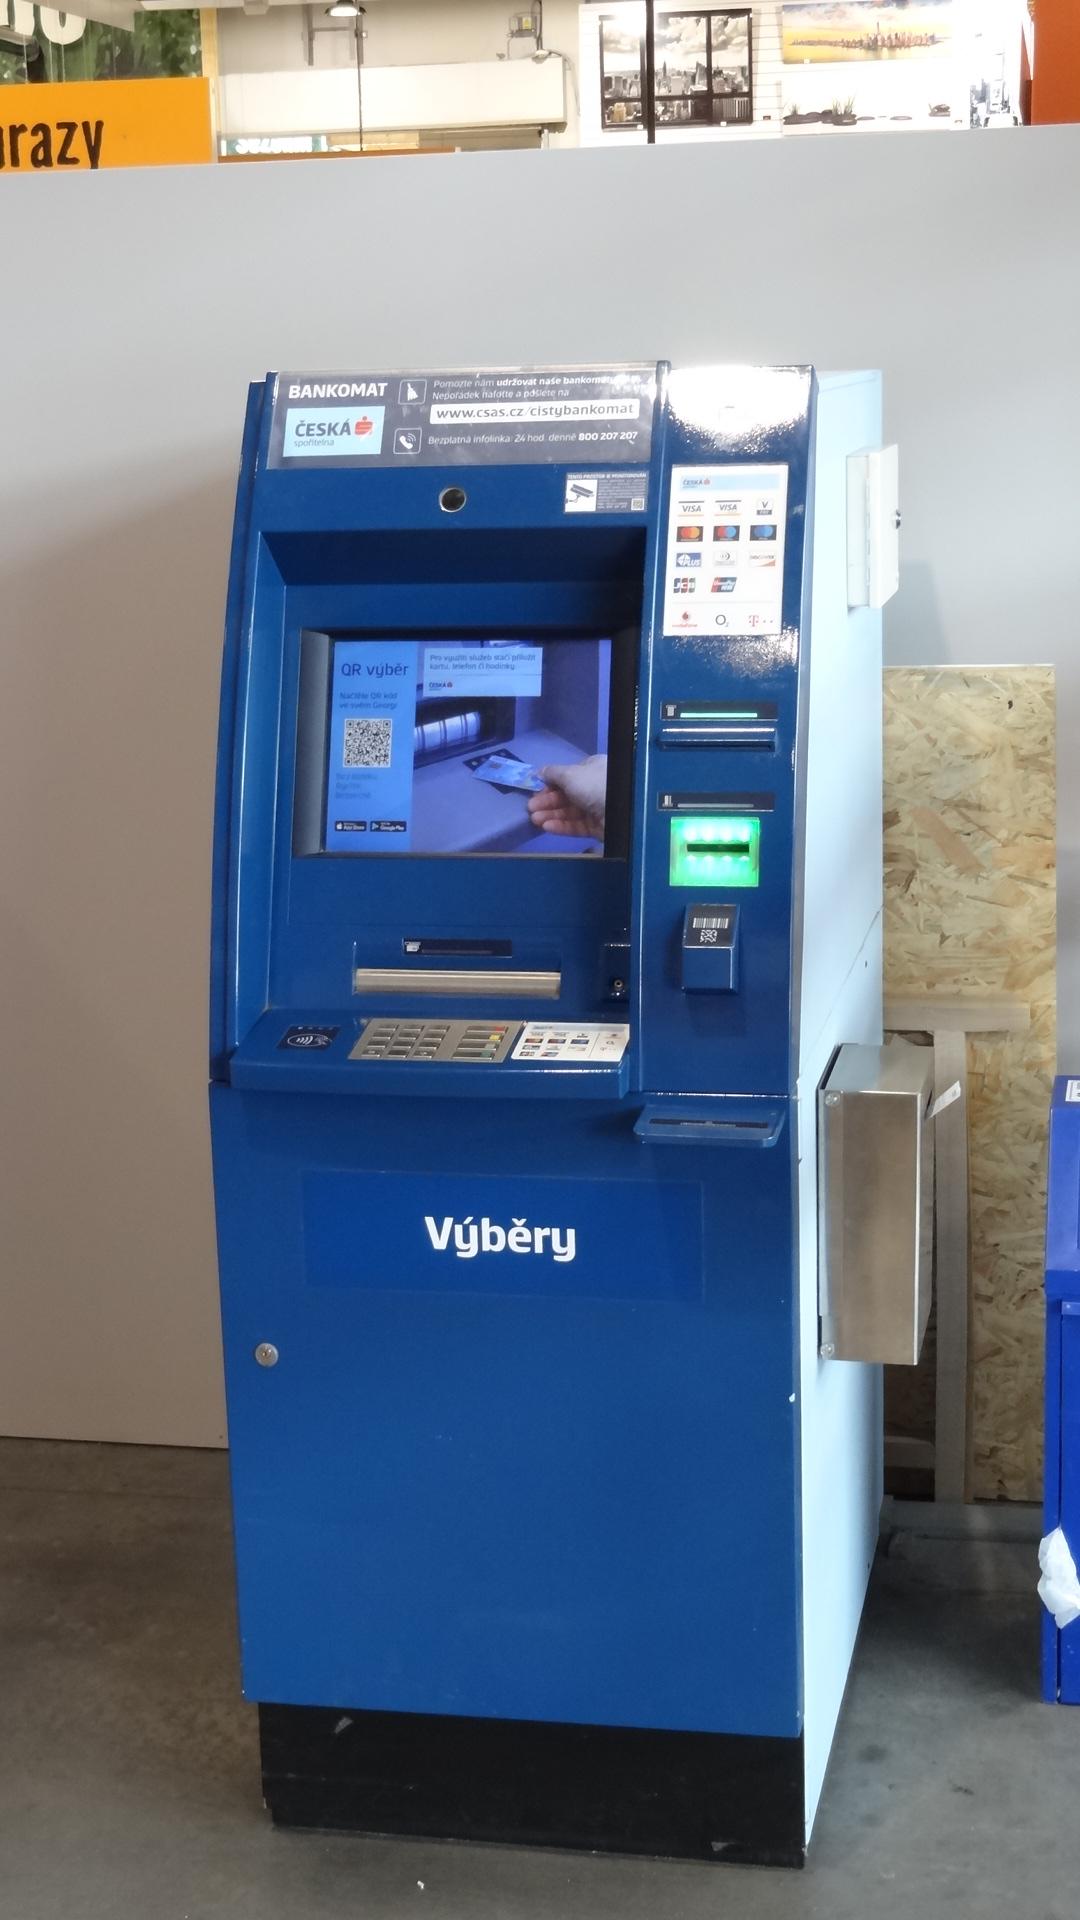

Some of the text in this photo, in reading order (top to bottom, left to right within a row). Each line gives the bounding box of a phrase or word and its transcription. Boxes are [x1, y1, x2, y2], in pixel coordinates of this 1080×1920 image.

[0, 120, 104, 169] razy
[433, 379, 472, 388] Pomozte
[474, 378, 494, 387] nám
[496, 377, 537, 386] udržovat
[539, 376, 561, 386] naše
[288, 382, 388, 399] BANKOMAT
[432, 390, 480, 400] Nepořádek
[437, 403, 634, 419] www.csas.cz/cistybankomat
[295, 419, 351, 437] ČESKÁ
[294, 438, 335, 448] spořitelna
[428, 435, 471, 446] Bezplatná
[514, 433, 526, 443] 24
[548, 432, 577, 442] denně
[578, 432, 598, 442] 800
[600, 431, 618, 441] 207
[619, 431, 638, 441] 207
[682, 505, 702, 513] VISA
[683, 559, 700, 567] PLUS
[341, 662, 409, 679] QR výběr
[424, 1216, 576, 1262] Výběry
